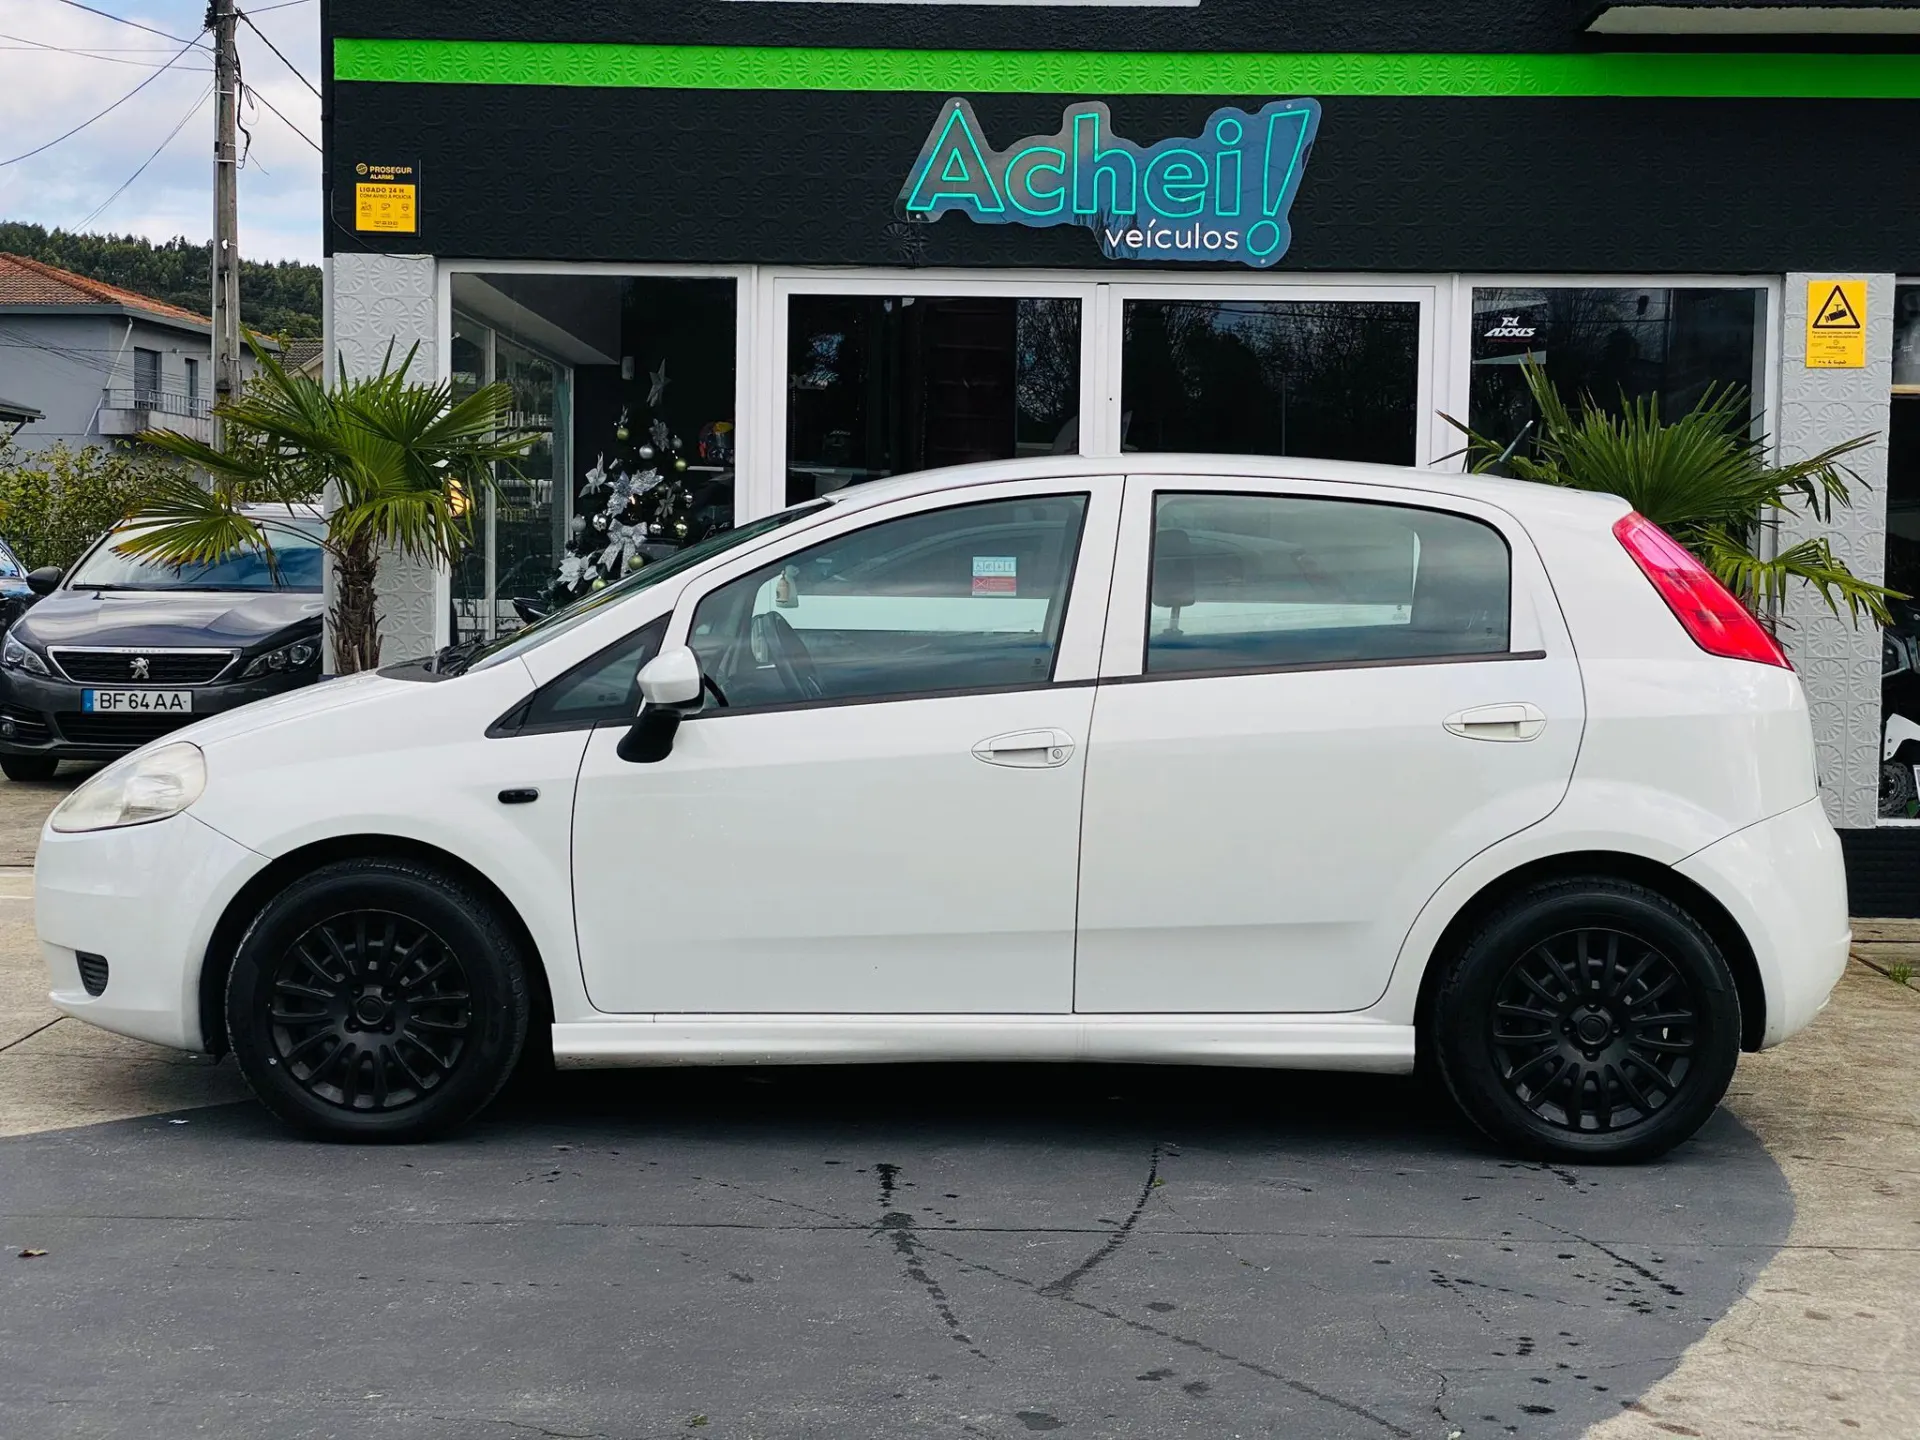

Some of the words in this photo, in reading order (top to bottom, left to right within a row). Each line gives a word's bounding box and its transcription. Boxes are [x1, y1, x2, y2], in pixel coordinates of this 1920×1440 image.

[369, 166, 412, 174] PROSEGUR
[907, 108, 1310, 257] Achei!
[1105, 219, 1239, 250] veículos
[1483, 327, 1537, 337] AXXIS
[100, 693, 126, 709] BF
[128, 693, 150, 709] 64
[153, 693, 184, 710] AA
